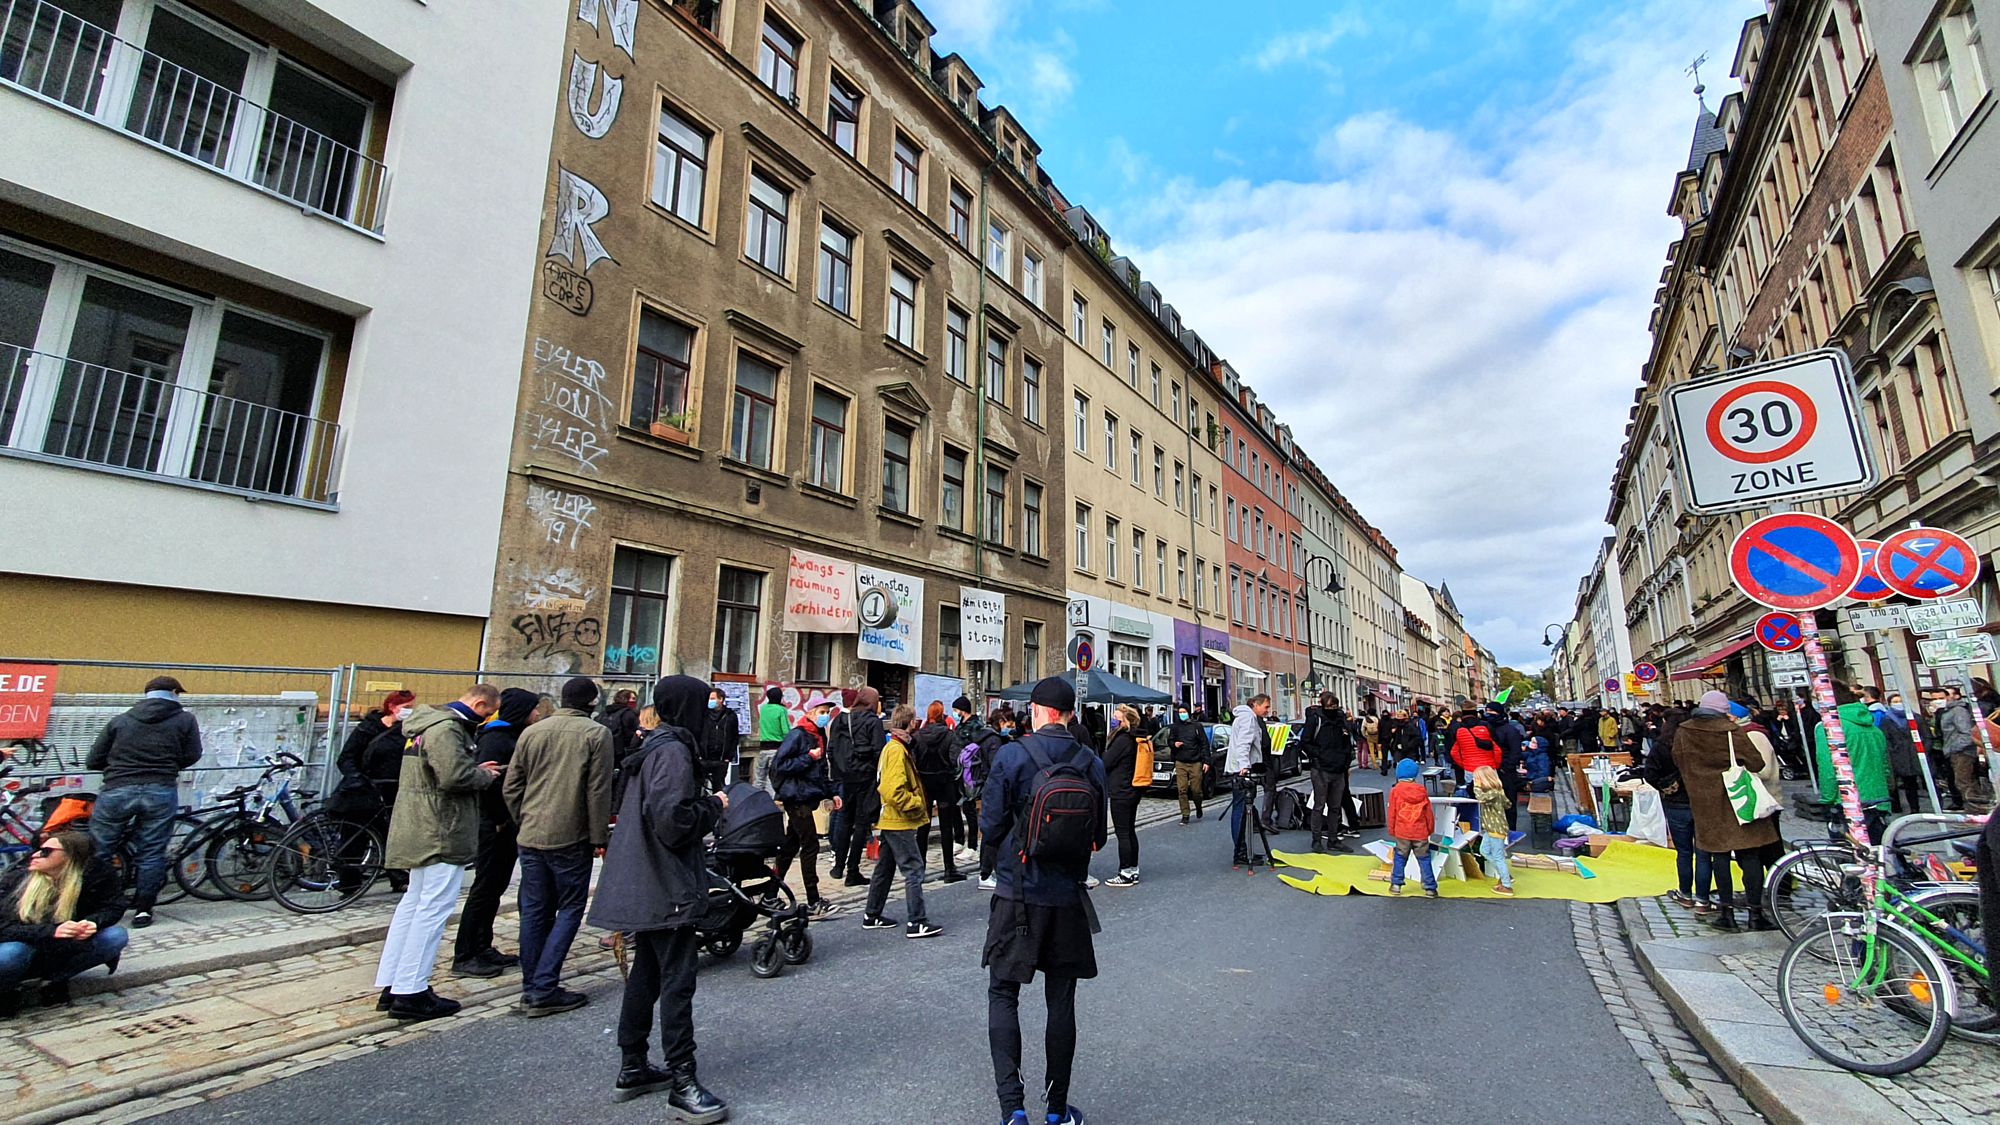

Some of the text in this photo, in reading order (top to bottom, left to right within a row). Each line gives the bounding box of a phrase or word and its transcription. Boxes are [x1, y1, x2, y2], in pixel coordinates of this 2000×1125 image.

[1726, 400, 1794, 444] 30
[1730, 461, 1818, 494] ZONE
[1958, 602, 1969, 613] 19
[1851, 611, 1860, 620] ab
[1962, 615, 1980, 625] Uhr
[1855, 622, 1865, 630] ab
